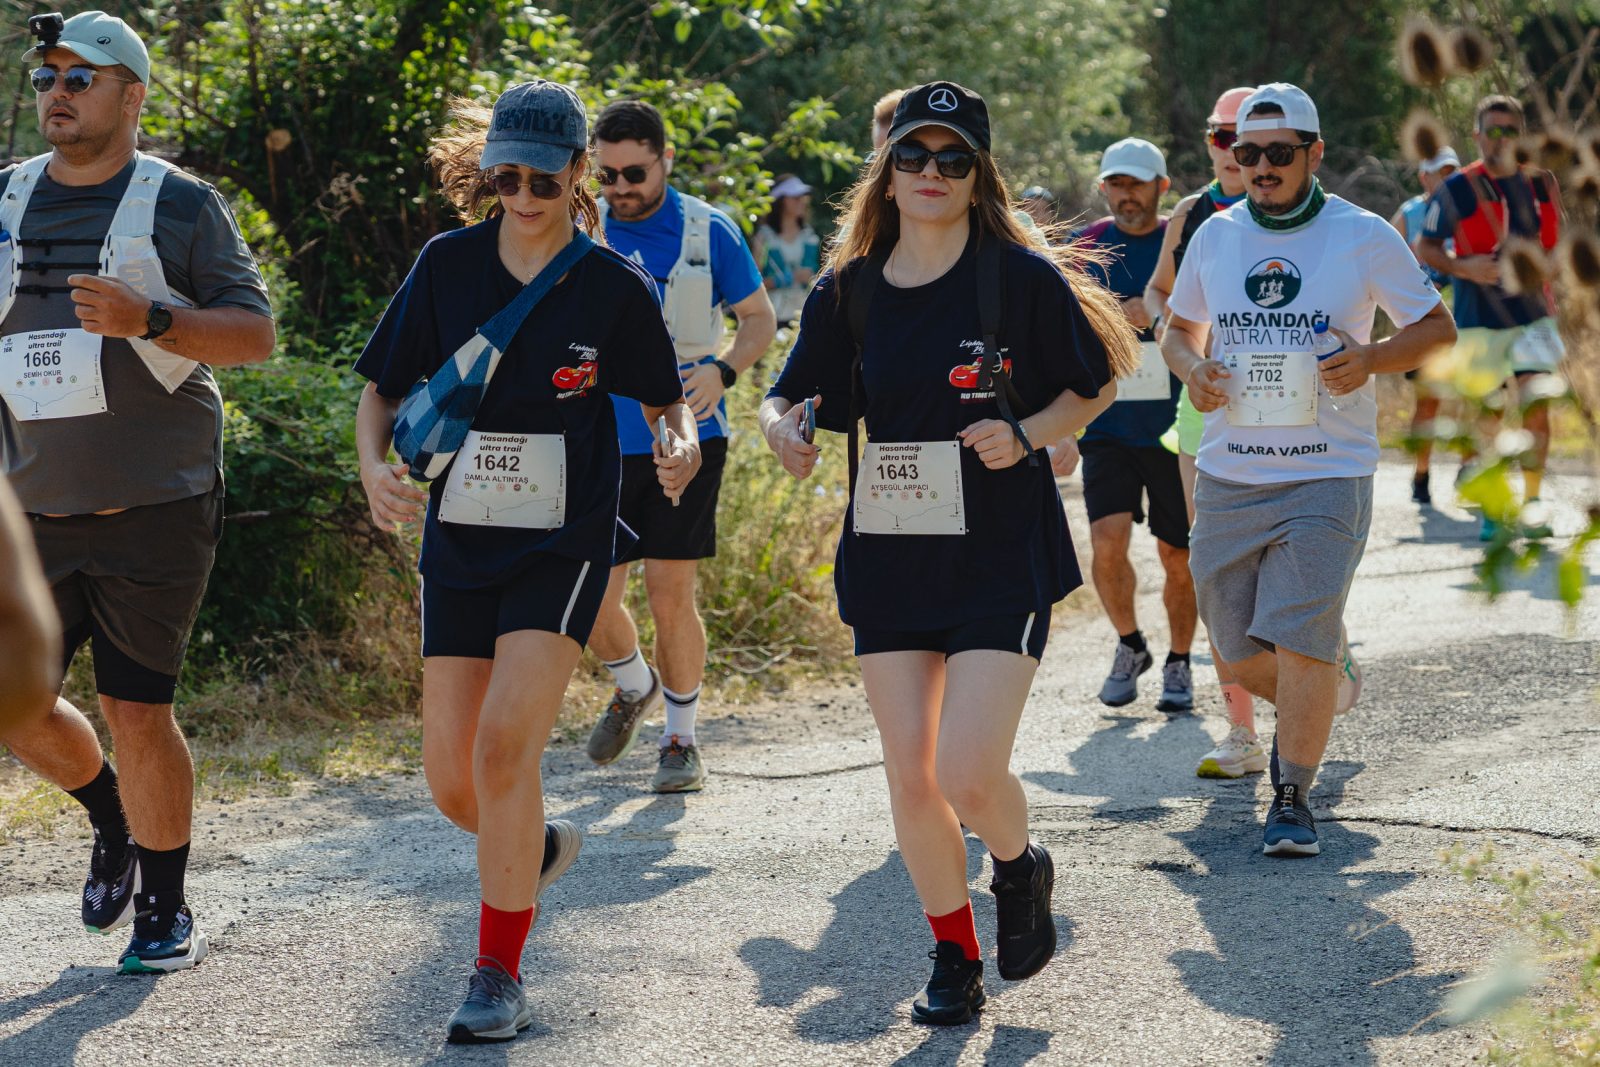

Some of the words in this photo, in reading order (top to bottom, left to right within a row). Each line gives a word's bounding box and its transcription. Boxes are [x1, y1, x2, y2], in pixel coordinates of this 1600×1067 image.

[28, 331, 67, 341] Hasandağı
[1221, 328, 1273, 346] ULTRA
[1277, 329, 1315, 346] TRA
[28, 342, 45, 350] ultra
[46, 340, 62, 348] trail
[24, 350, 61, 368] 1666
[1251, 353, 1288, 361] Hasandağı
[23, 370, 42, 379] SEMİH
[43, 369, 62, 377] OKUR
[1247, 369, 1283, 382] 1702
[480, 434, 528, 444] Hasandağı
[480, 444, 501, 452] ultra
[503, 445, 522, 453] trail
[879, 444, 922, 453] Hasandağı
[1227, 442, 1276, 456] IHLARA
[1278, 443, 1328, 456] VADISI
[901, 453, 918, 461] trail
[473, 454, 520, 472] 1642
[876, 464, 919, 480] 1643
[464, 473, 490, 482] DAMLA
[492, 475, 529, 484] ALTINTAŞ
[871, 483, 902, 491] AYŞEGÜL
